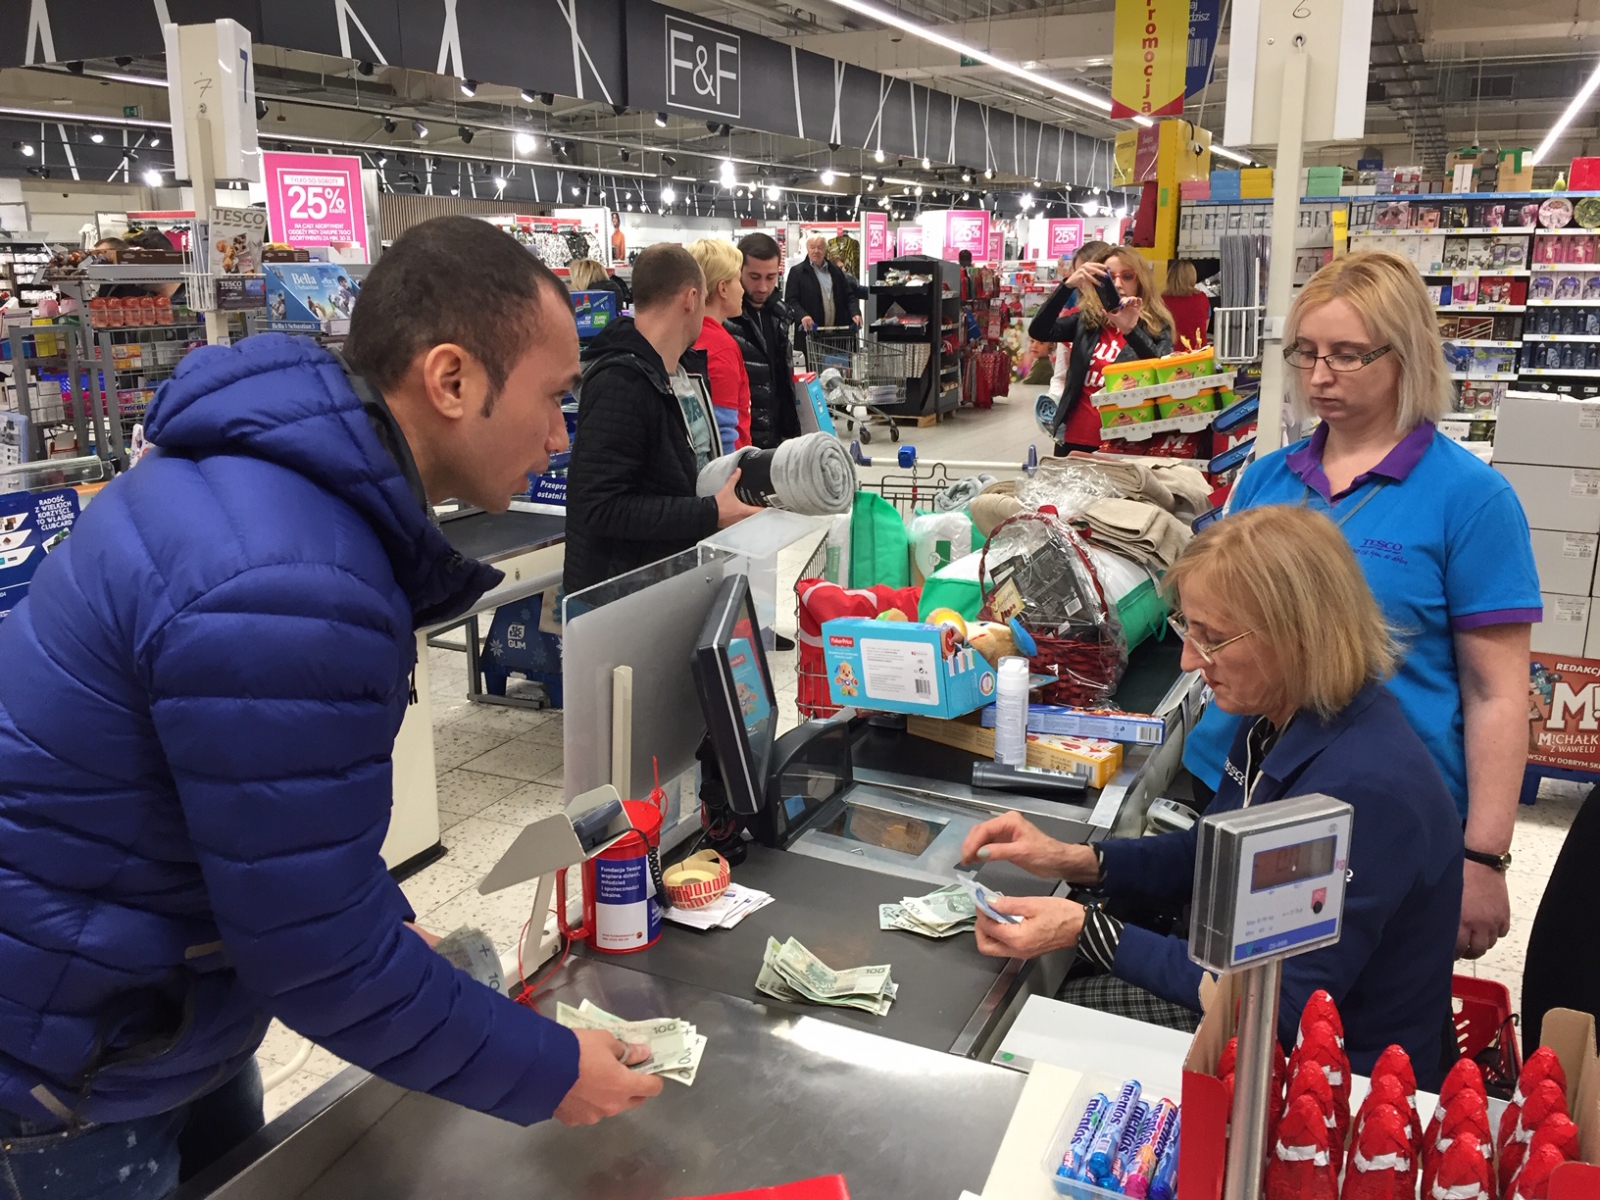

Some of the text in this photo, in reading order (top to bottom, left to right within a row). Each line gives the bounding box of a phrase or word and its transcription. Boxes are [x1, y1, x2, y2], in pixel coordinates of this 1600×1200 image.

[1140, 0, 1159, 113] romocja
[670, 29, 737, 104] F&F
[194, 77, 213, 98] 7
[288, 185, 345, 220] 25%
[212, 208, 264, 225] TESCO
[1055, 230, 1077, 244] 25%
[291, 273, 317, 285] Bella
[540, 480, 567, 491] Przepra
[39, 494, 65, 506] RADOŚĆ
[537, 492, 562, 500] ostatni
[42, 501, 72, 512] WIELKICH
[40, 519, 73, 531] CLUBCARD
[1363, 538, 1403, 551] TESCO
[507, 639, 527, 650] GUM
[1556, 662, 1600, 677] REDAKCJ
[1537, 733, 1600, 746] M!CHAŁK
[1550, 745, 1596, 754] Z WAWELU
[1528, 753, 1548, 762] WSZE
[1557, 757, 1588, 768] DOBRYM
[604, 884, 640, 892] społeczności
[488, 971, 500, 992] 10
[653, 1023, 677, 1034] 100
[1110, 1084, 1135, 1125] mentos
[1070, 1098, 1101, 1145] mentos
[1119, 1105, 1146, 1155] mentos
